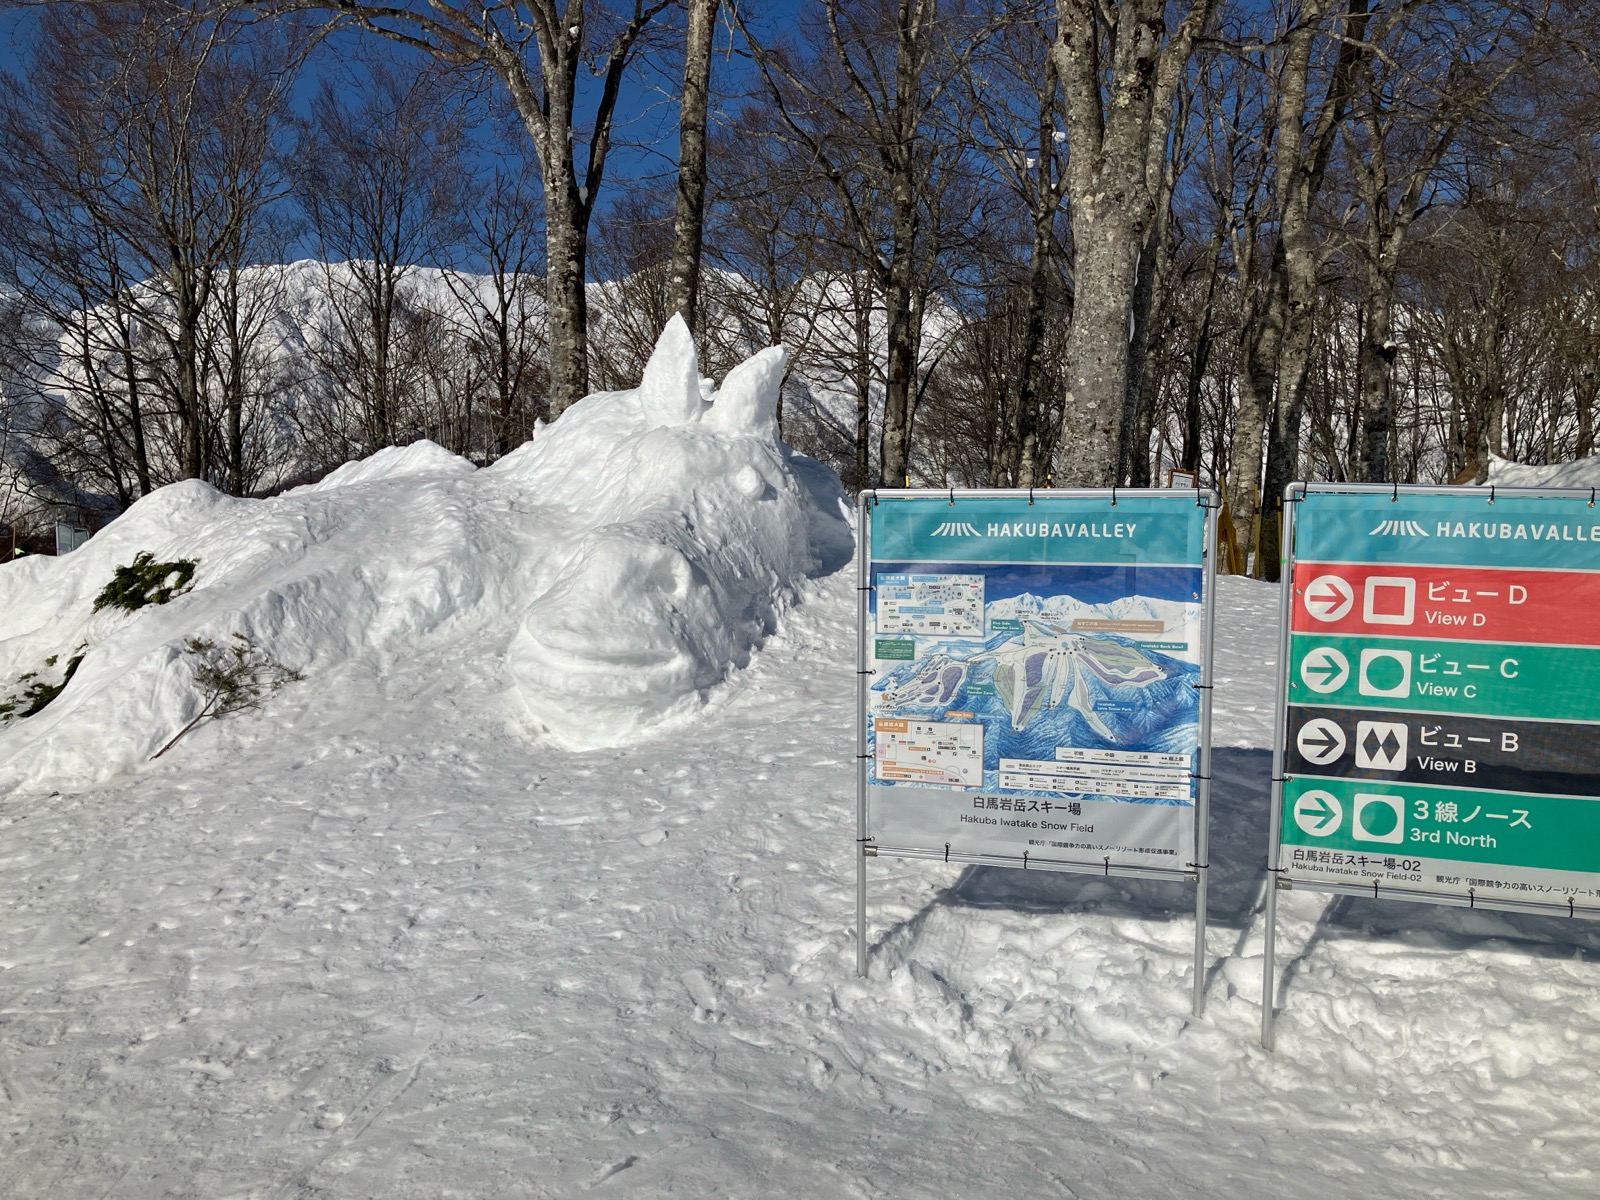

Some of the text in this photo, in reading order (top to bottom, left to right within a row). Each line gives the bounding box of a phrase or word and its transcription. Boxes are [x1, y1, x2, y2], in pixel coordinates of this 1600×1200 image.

[986, 522, 1137, 538] HAKUBAVALLEY
[1428, 580, 1528, 605] ビュー D
[1425, 610, 1487, 627] View D
[1420, 652, 1519, 679] ビュー C
[1416, 681, 1477, 699] View C
[1420, 725, 1519, 753] ビュー B
[1417, 756, 1477, 774] View B
[973, 795, 1082, 816] 白馬岩岳スキー場
[960, 814, 1094, 833] Hakuba Iwatake Snow Field
[1409, 827, 1497, 849] 3rd North
[1293, 848, 1422, 872] 白馬岩岳スキー場-02
[1291, 862, 1422, 882] Hakuba Iwatake Snow Field-02
